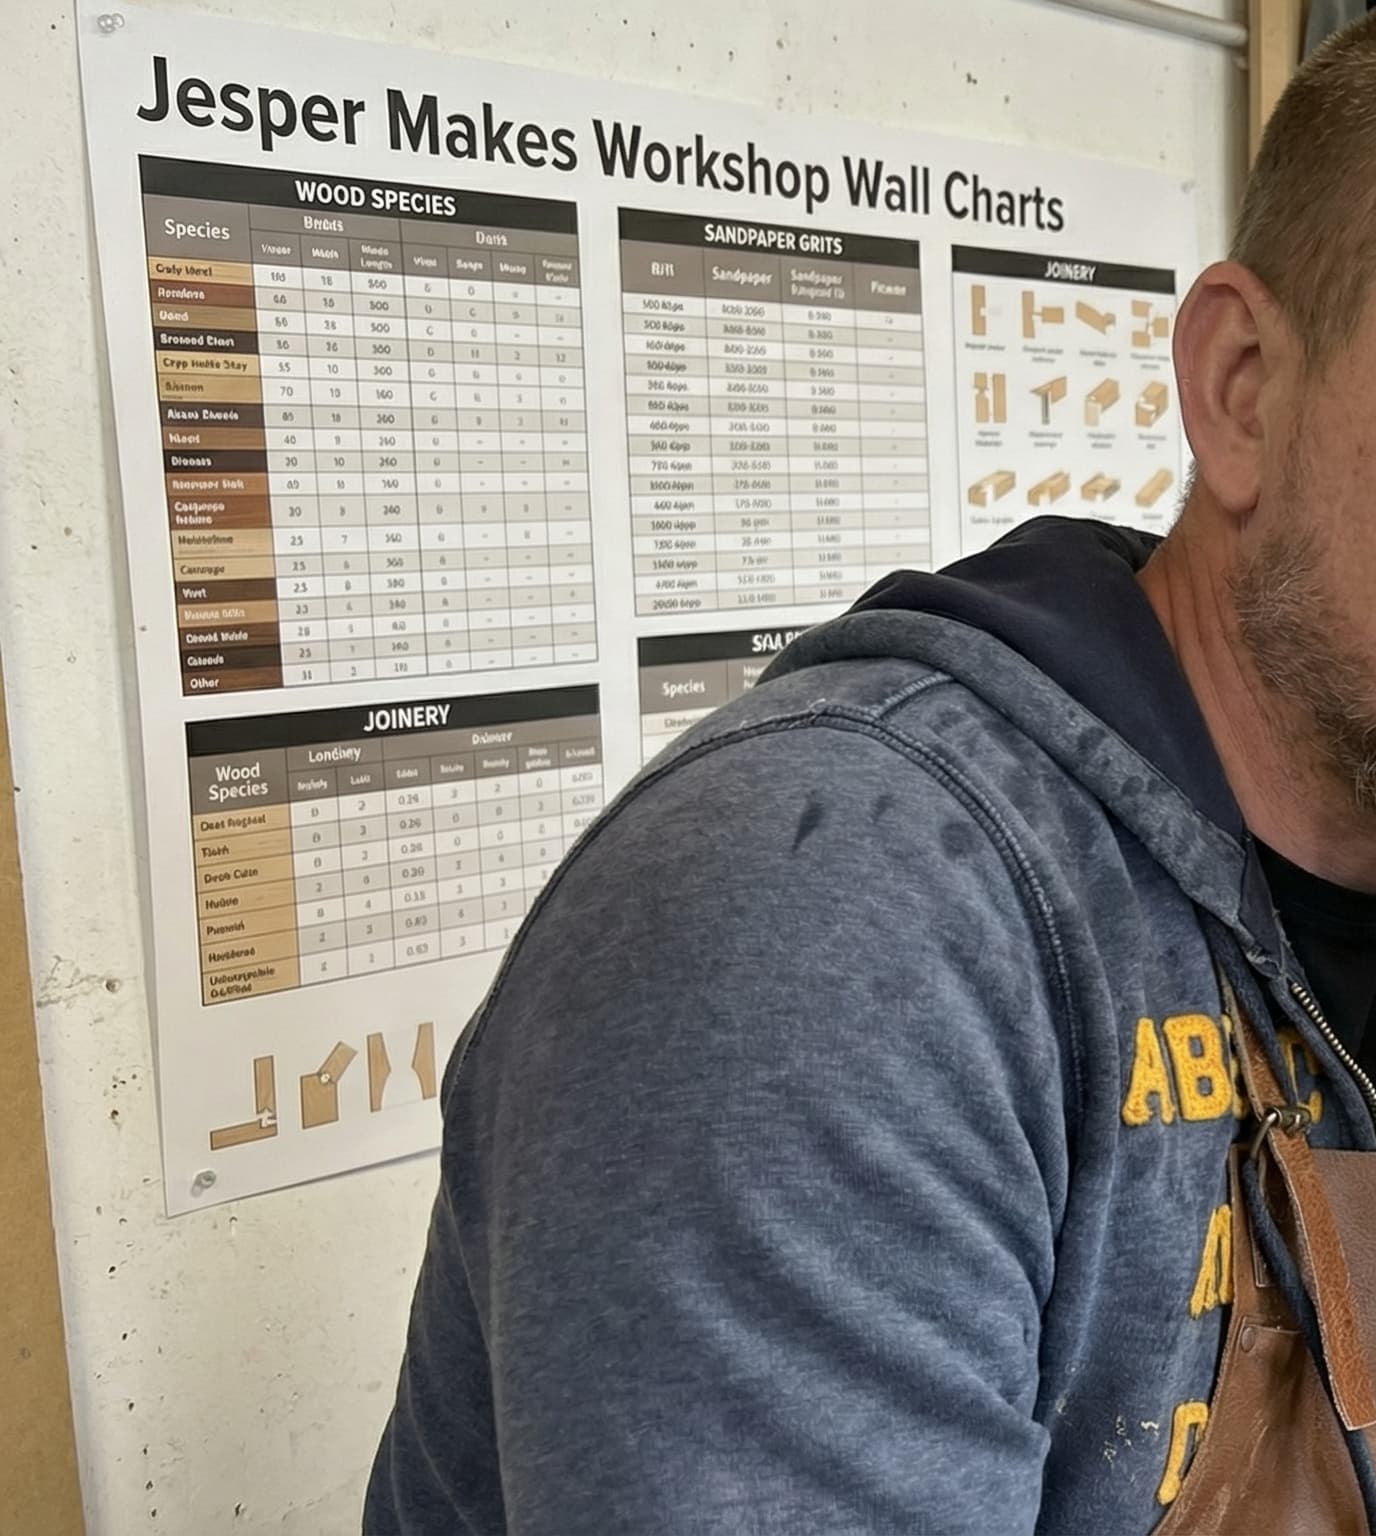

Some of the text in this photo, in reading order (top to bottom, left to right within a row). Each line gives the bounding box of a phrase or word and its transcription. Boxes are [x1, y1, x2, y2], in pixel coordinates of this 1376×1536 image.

[137, 56, 1064, 232] Jesper Makes Workshop Wall Charts
[294, 180, 456, 216] WOOD SPECIES
[164, 218, 231, 240] Species
[704, 224, 843, 254] SANDPAPER GRITS
[1044, 261, 1096, 281] JOINERY
[363, 704, 450, 731] JOINERY
[216, 762, 260, 781] Wood
[209, 781, 268, 802] Species
